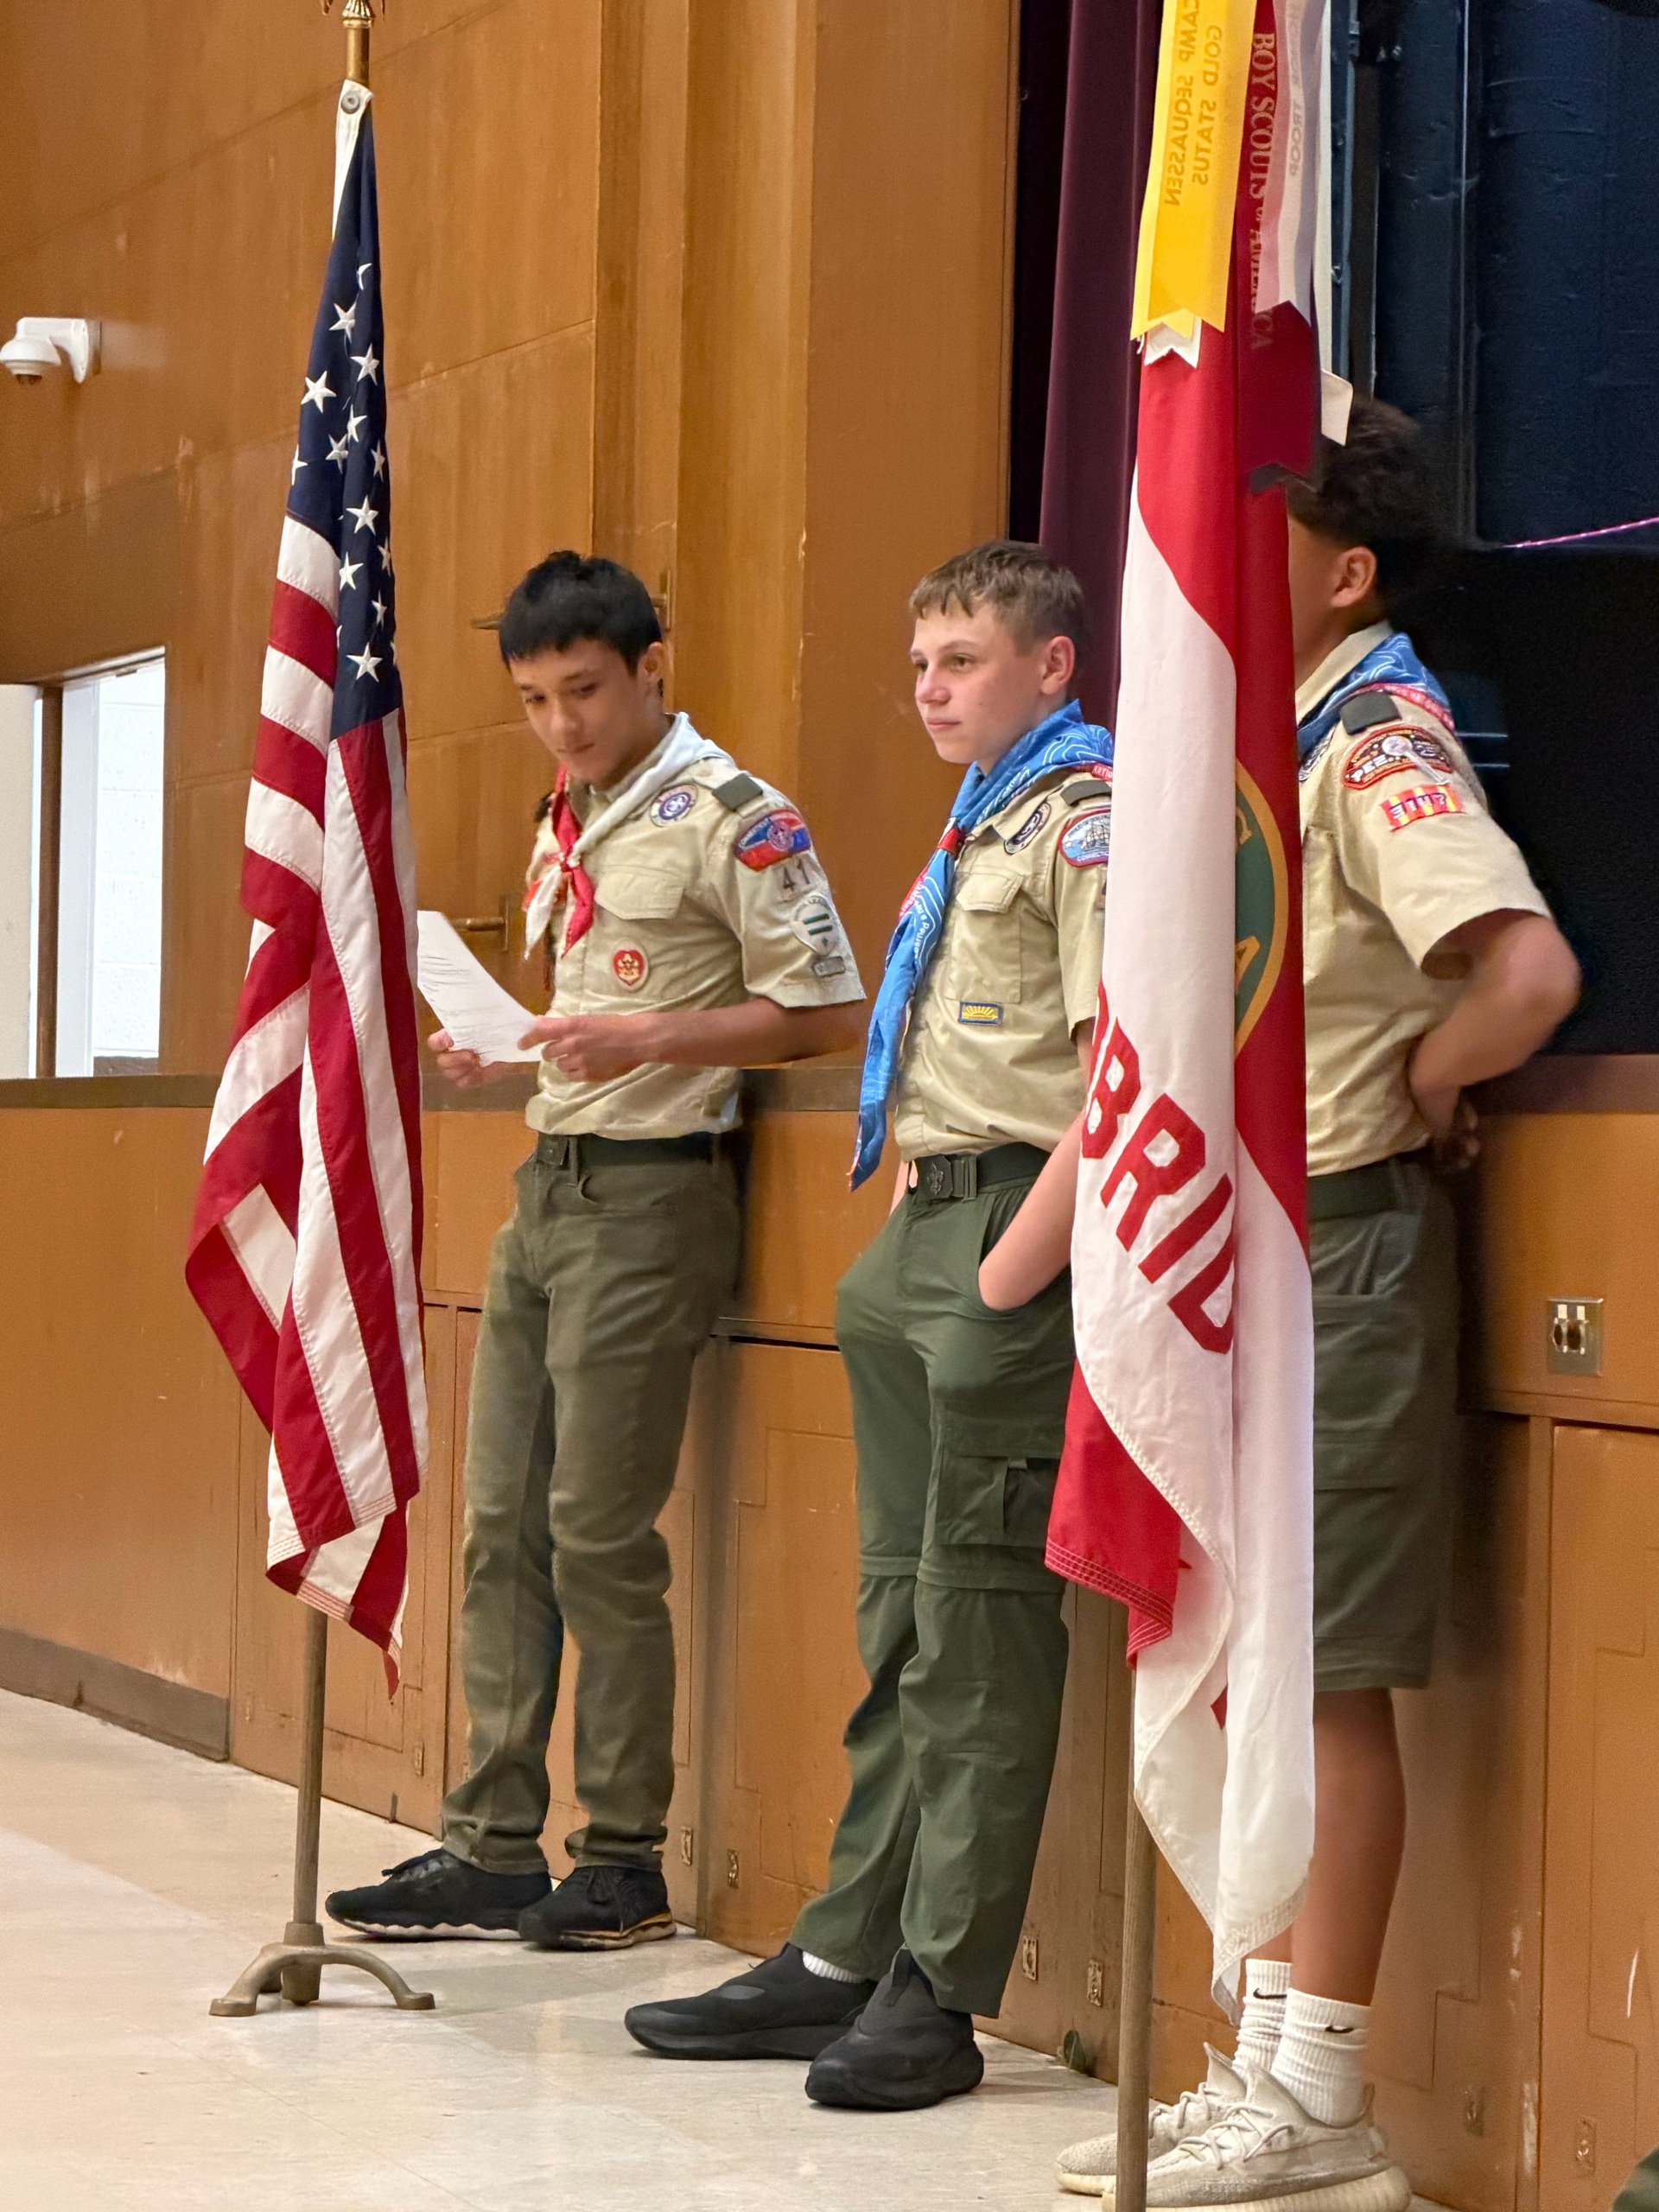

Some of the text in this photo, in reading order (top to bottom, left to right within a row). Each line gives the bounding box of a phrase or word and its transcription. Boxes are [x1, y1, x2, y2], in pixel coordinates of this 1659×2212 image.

[1252, 33, 1276, 91] BOY
[1249, 96, 1274, 200] SCOUTS
[782, 858, 810, 893] 41
